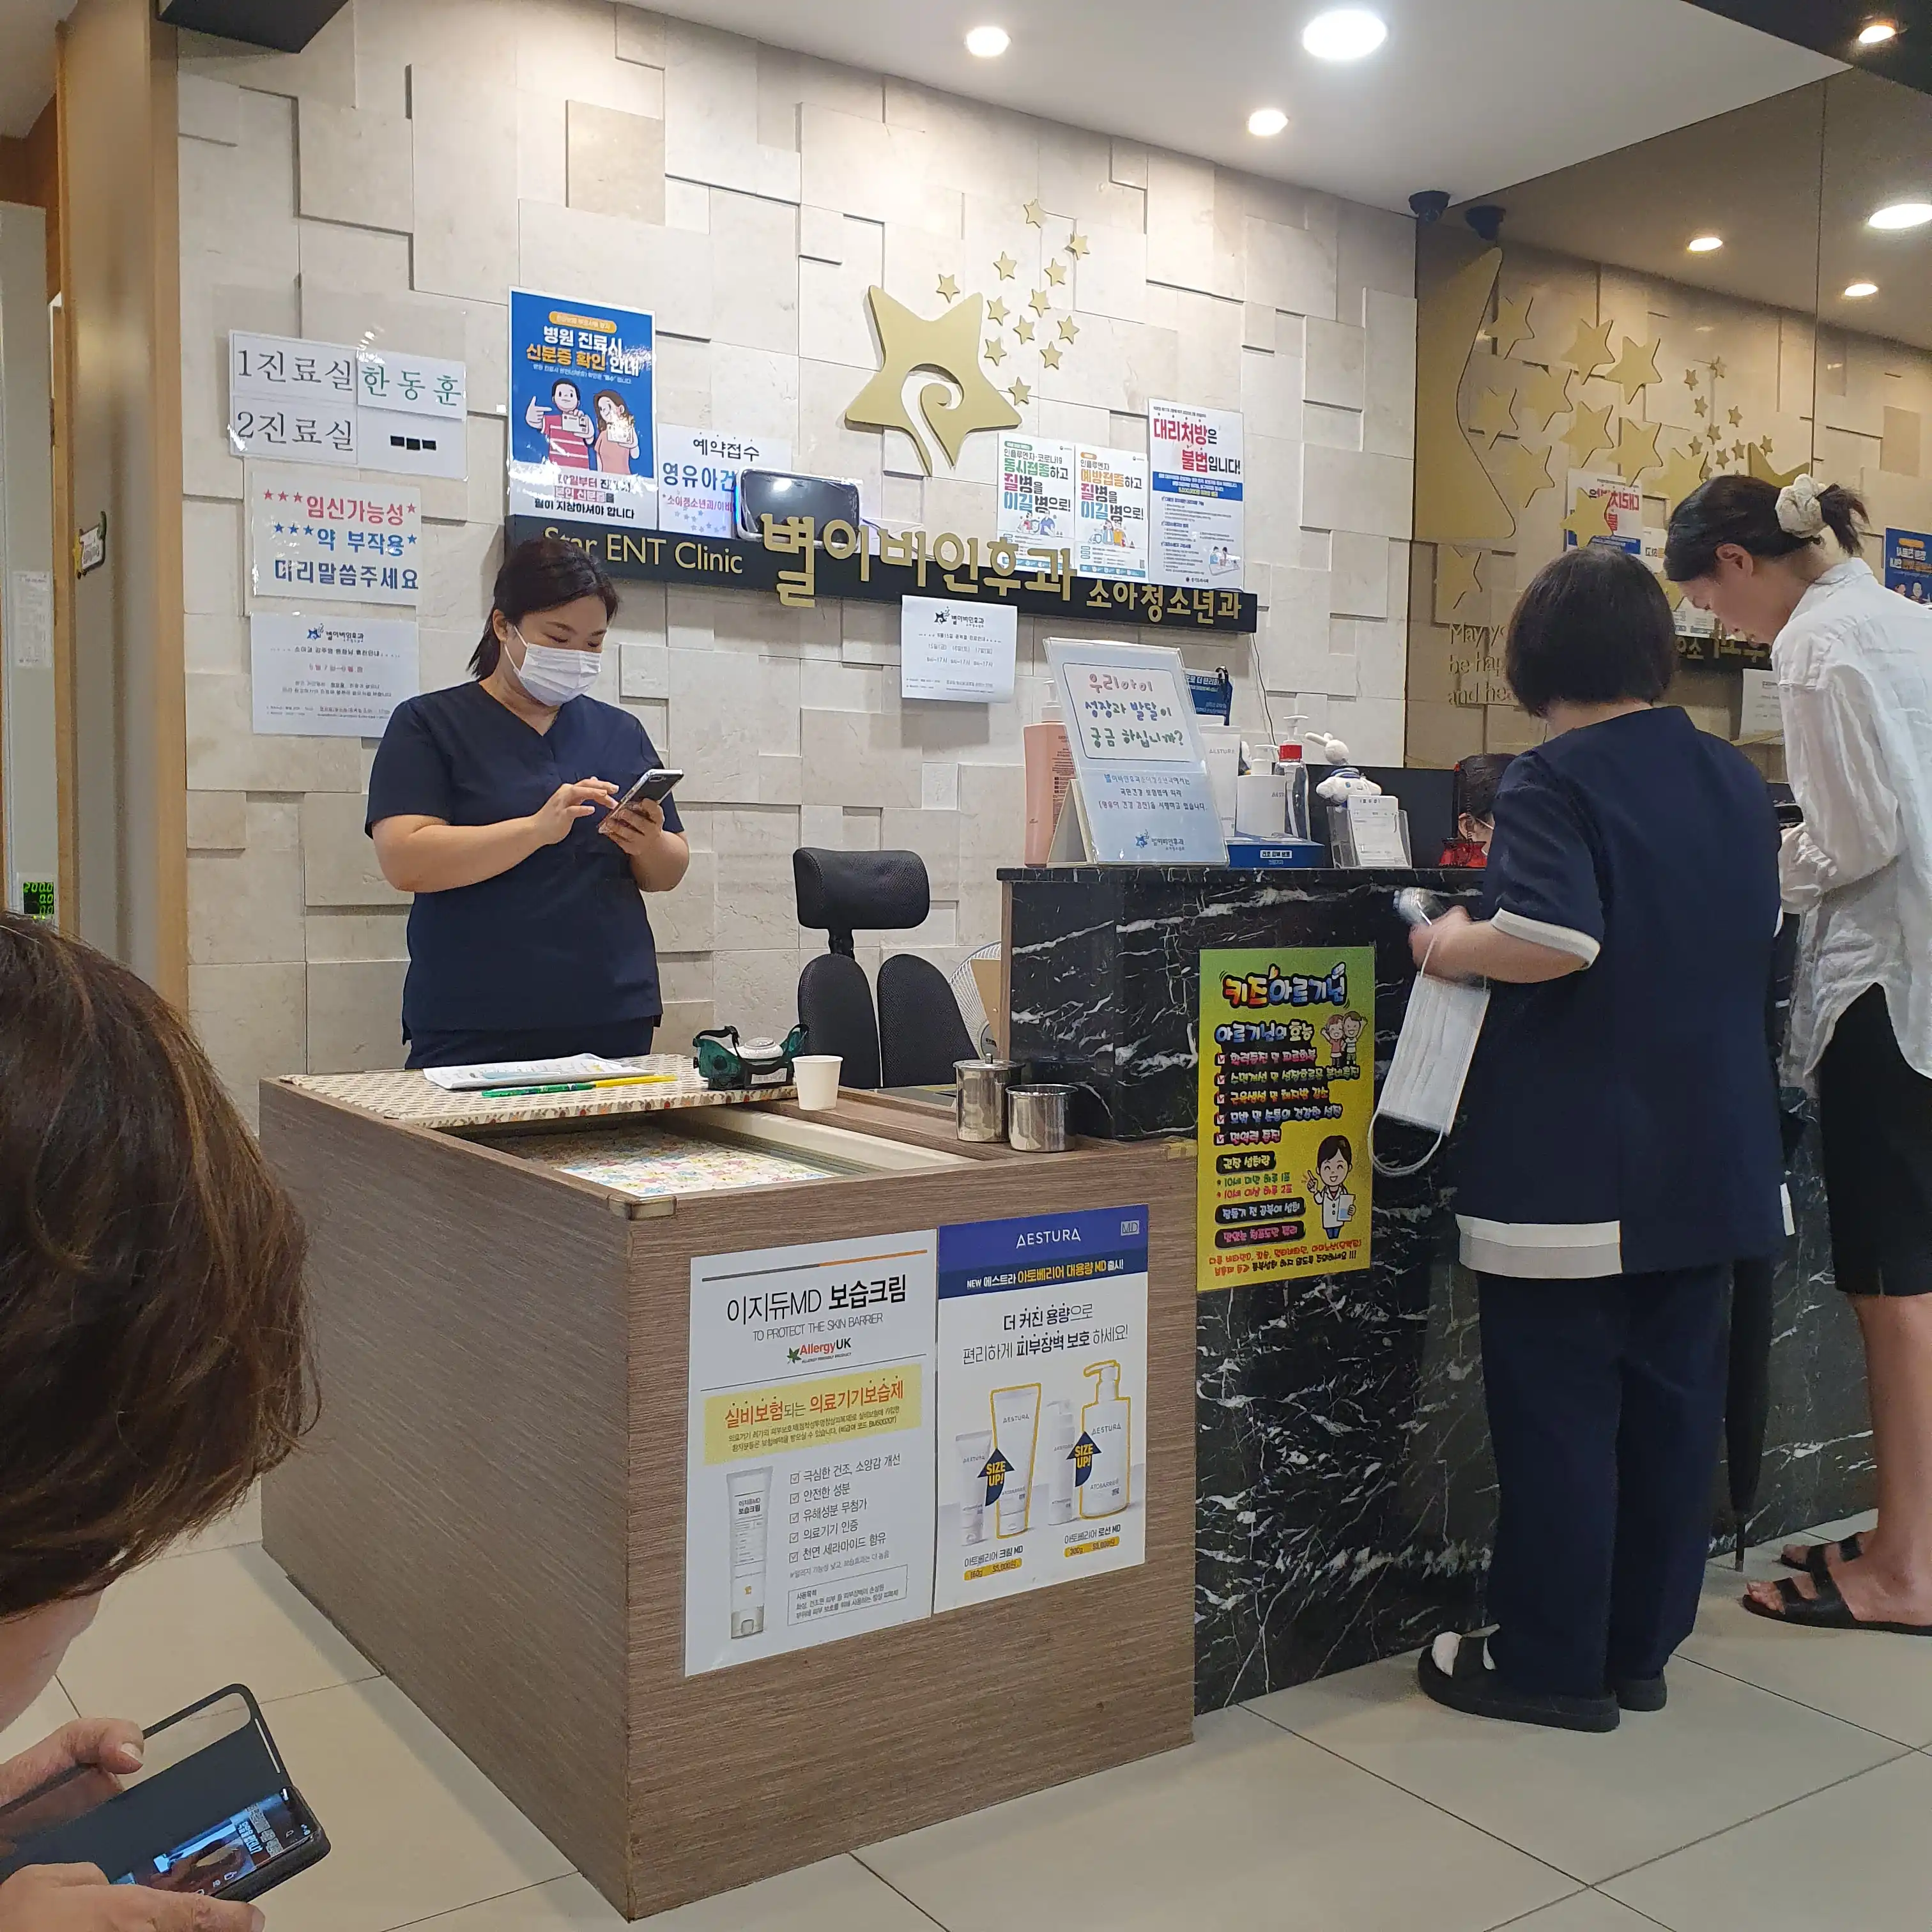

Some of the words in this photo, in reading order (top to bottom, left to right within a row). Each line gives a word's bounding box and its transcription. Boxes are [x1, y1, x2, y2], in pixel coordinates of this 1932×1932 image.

[544, 325, 574, 347] 병원
[237, 349, 353, 392] 1진료실
[576, 351, 606, 372] 확인
[237, 411, 354, 452] 2진료실
[1153, 418, 1217, 445] 대리처방은
[693, 439, 760, 462] 예약접수
[1181, 449, 1241, 475] 불법입니다!
[1004, 457, 1069, 480] 동시접종하고
[1004, 473, 1043, 495] 질병을
[1080, 483, 1117, 504] 질병을
[307, 494, 404, 526] 임신가능성
[606, 506, 635, 519] 합니다
[1004, 491, 1033, 512] 이길
[1080, 501, 1108, 520] 이길
[318, 528, 335, 551] 약
[606, 533, 666, 565] ENT
[675, 541, 743, 574] Clinic
[275, 558, 419, 590] 미리말씀주세요
[761, 512, 1077, 608] 별이비인후과
[1086, 579, 1241, 624] 소아청소년과
[951, 615, 985, 625] 별이비인후과
[1089, 673, 1153, 694] 우리아이
[1085, 700, 1126, 719] 성장과
[1130, 701, 1172, 721] 발달이
[1090, 726, 1115, 749] 궁금
[1121, 729, 1184, 749] 하십니까?
[1288, 1021, 1313, 1041] 효능
[1016, 1227, 1081, 1249] AESTURA
[1122, 1221, 1138, 1234] MD
[967, 1278, 982, 1289] NEW
[983, 1273, 1017, 1288] 에스트라
[1018, 1266, 1065, 1284] 아토베리어
[1067, 1261, 1094, 1277] 대용량
[1095, 1260, 1107, 1272] MD
[726, 1289, 822, 1325] 이지듀MD
[829, 1274, 907, 1311] 보습크림
[753, 1330, 764, 1342] TO
[767, 1323, 806, 1340] PROTECT
[808, 1321, 825, 1333] THE
[827, 1319, 847, 1331] SKIN
[848, 1312, 884, 1328] BARRIER
[1003, 1314, 1016, 1331] 더
[1019, 1310, 1043, 1329] 커진
[1046, 1303, 1093, 1326] 용량으로
[800, 1337, 852, 1355] AllergyUK
[963, 1342, 1013, 1365] 편리하게
[1016, 1335, 1064, 1357] 피부장벽
[1067, 1330, 1091, 1349] 보호
[724, 1400, 806, 1429] 실비보험되는
[809, 1380, 903, 1413] 의료기기보습제
[1091, 1422, 1122, 1436] AESTURA
[1075, 1443, 1094, 1458] SIZE
[1077, 1455, 1091, 1469] UP!
[802, 1465, 831, 1483] 극심한
[855, 1457, 882, 1473] 소양감
[884, 1452, 901, 1468] 개선
[986, 1460, 1006, 1476] SIZE
[988, 1473, 1004, 1487] UP!
[802, 1485, 831, 1503] 안전한
[832, 1482, 852, 1498] 성분
[802, 1504, 839, 1522] 유해성분
[841, 1498, 868, 1515] 무첨가
[802, 1524, 839, 1541] 의료기기
[840, 1518, 859, 1534] 인증
[1098, 1526, 1111, 1537] 로션
[802, 1546, 821, 1561] 천연
[822, 1537, 867, 1556] 세라마이드
[869, 1531, 887, 1547] 함유
[999, 1547, 1013, 1559] 크림
